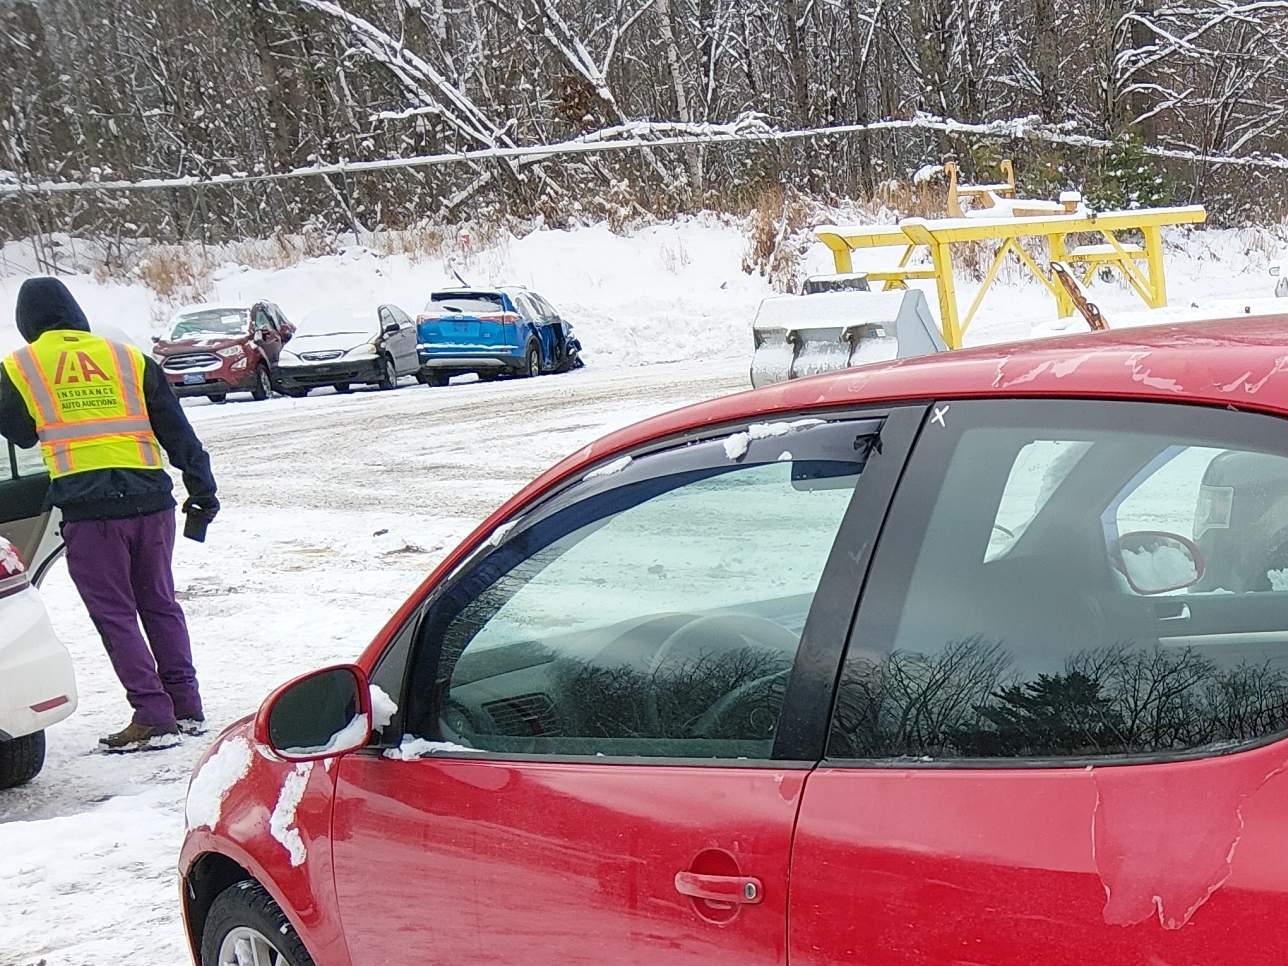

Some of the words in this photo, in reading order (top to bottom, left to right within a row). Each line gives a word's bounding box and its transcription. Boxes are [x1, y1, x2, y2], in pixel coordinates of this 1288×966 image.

[56, 388, 114, 399] INSURANCE
[62, 401, 81, 409] AUTO
[82, 399, 117, 408] AUCTIONS
